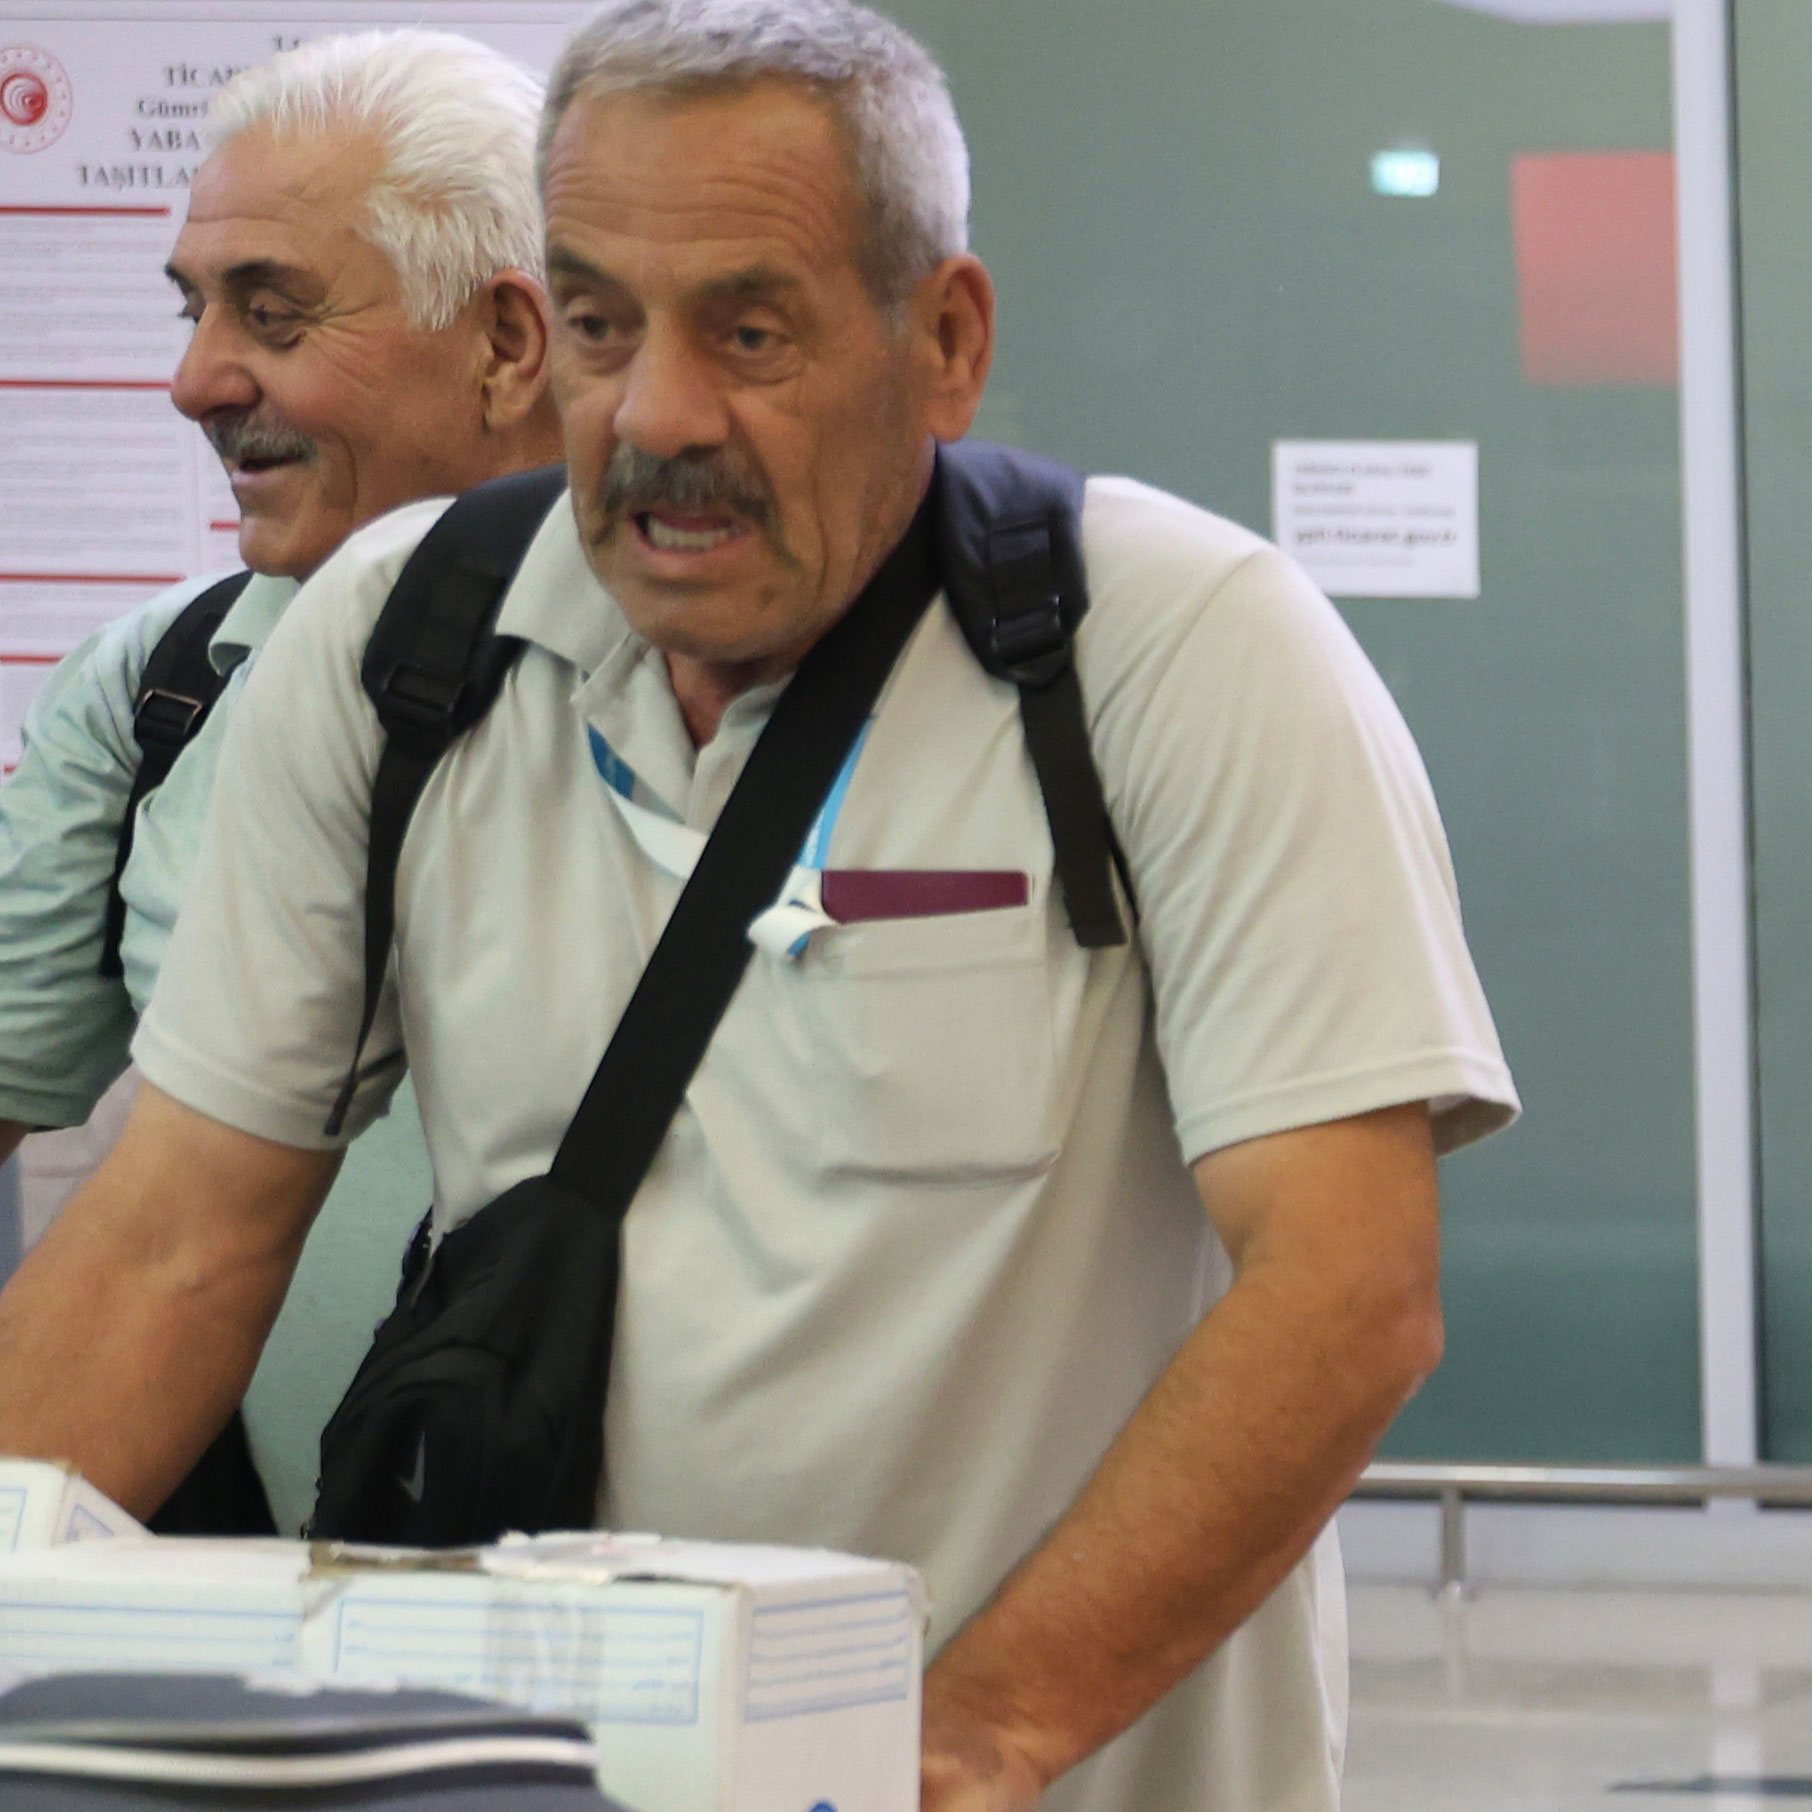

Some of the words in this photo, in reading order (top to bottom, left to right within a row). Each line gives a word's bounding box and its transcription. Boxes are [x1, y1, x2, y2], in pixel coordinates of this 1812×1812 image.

[165, 62, 246, 86] TİCAR
[130, 128, 200, 150] YABA
[78, 163, 198, 190] TAŞITLA
